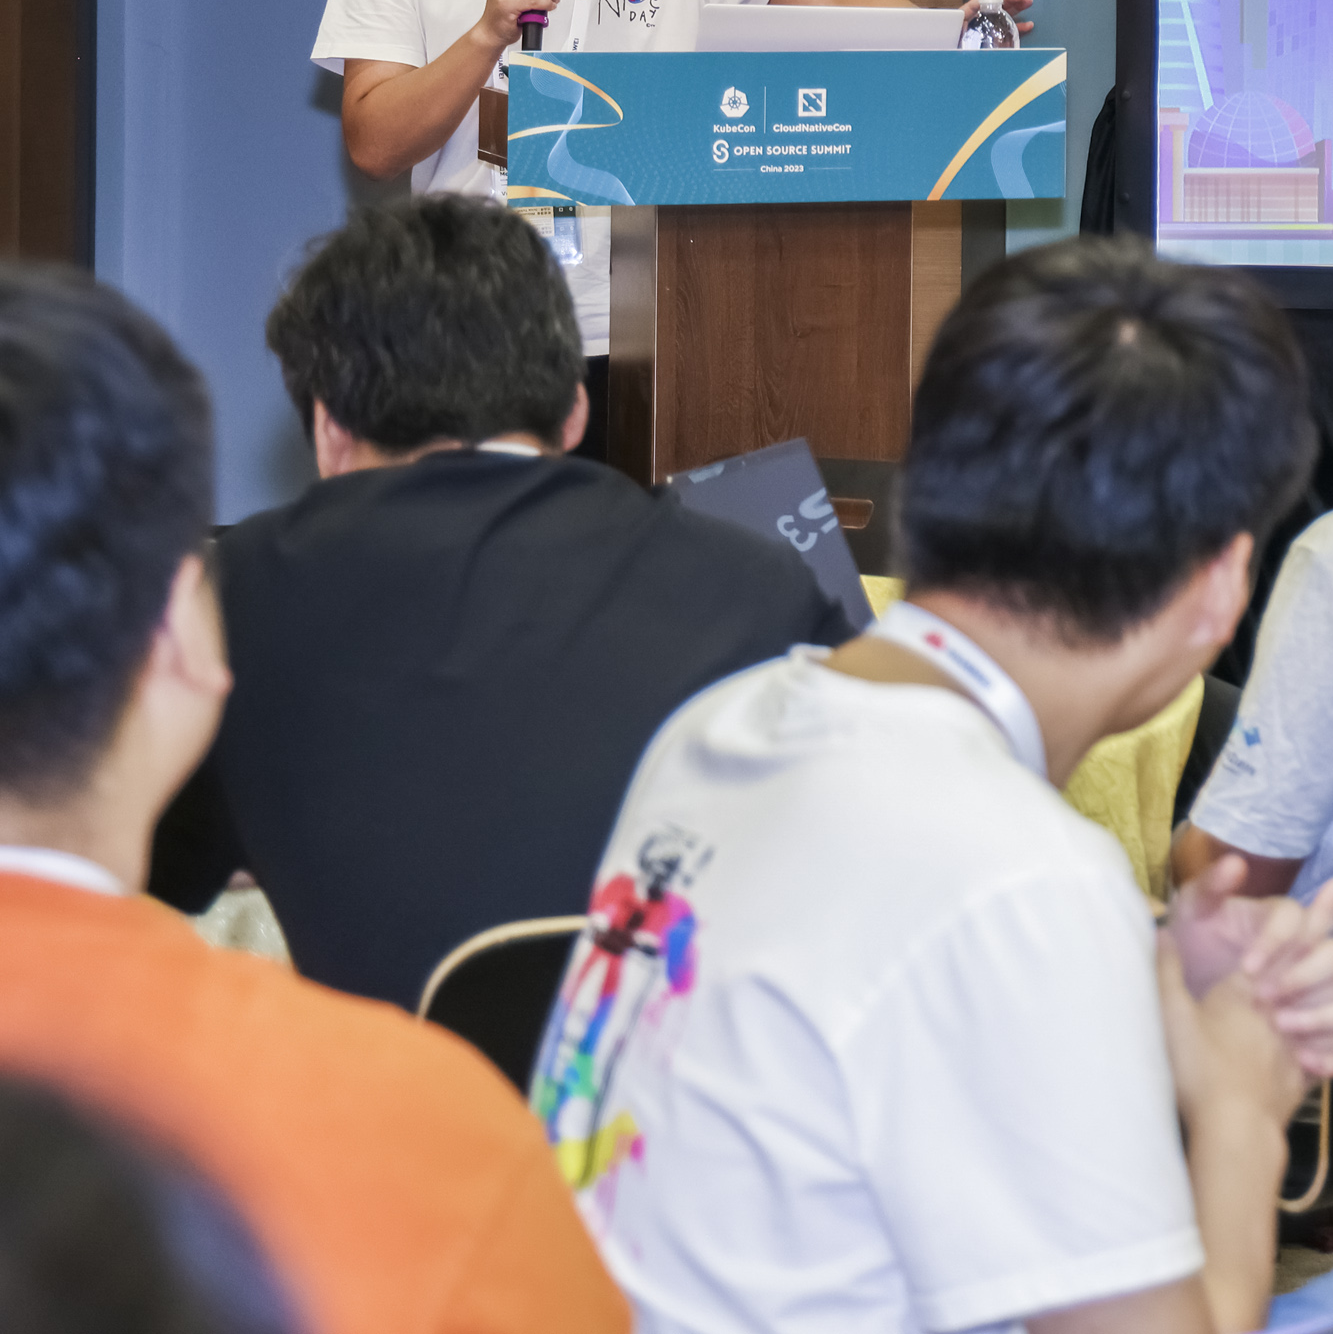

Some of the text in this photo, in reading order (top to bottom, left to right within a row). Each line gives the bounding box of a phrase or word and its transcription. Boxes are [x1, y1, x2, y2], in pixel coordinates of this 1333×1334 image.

[629, 9, 657, 23] DAY
[713, 124, 756, 133] KubeCon
[772, 123, 852, 133] CloudNativeCon
[733, 146, 763, 156] OPEN
[766, 146, 808, 155] SOURCE
[810, 145, 852, 154] SUMMIT
[760, 165, 782, 173] China
